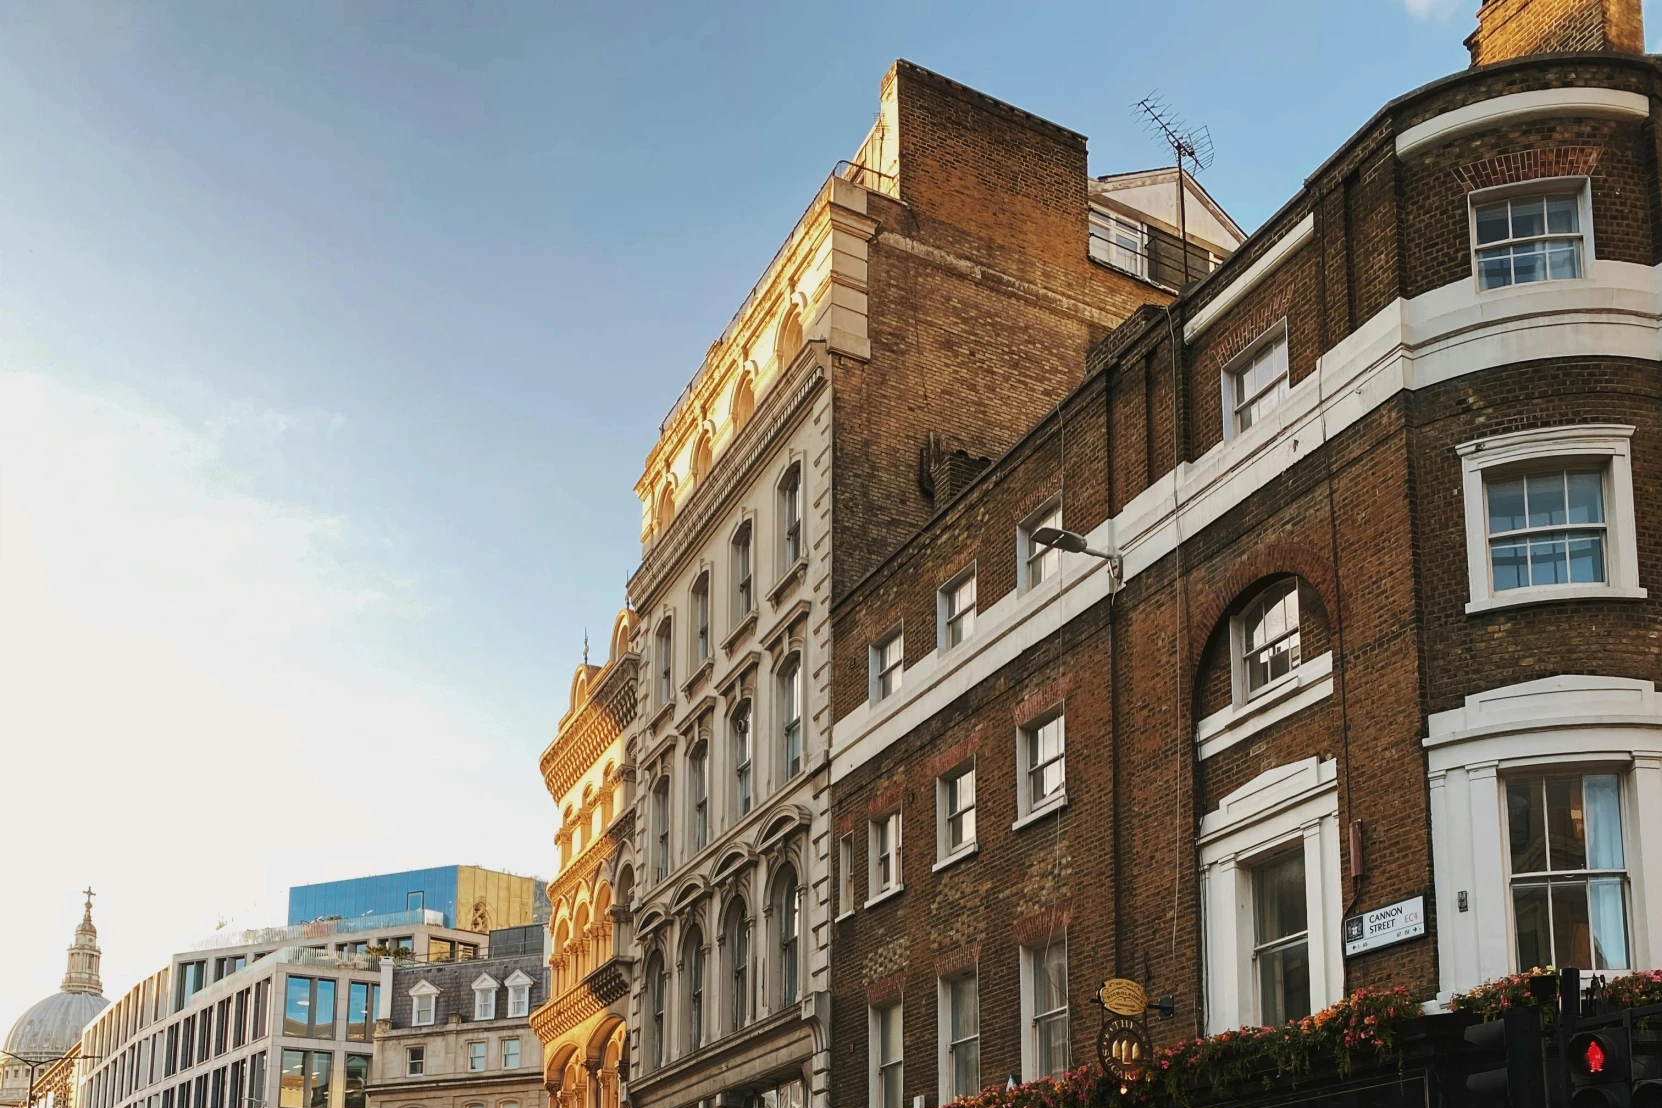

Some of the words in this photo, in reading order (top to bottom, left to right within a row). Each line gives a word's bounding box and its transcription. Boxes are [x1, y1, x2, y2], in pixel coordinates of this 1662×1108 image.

[1369, 906, 1403, 923] CANNON
[1369, 918, 1396, 934] STREET
[1404, 912, 1419, 924] EC4
